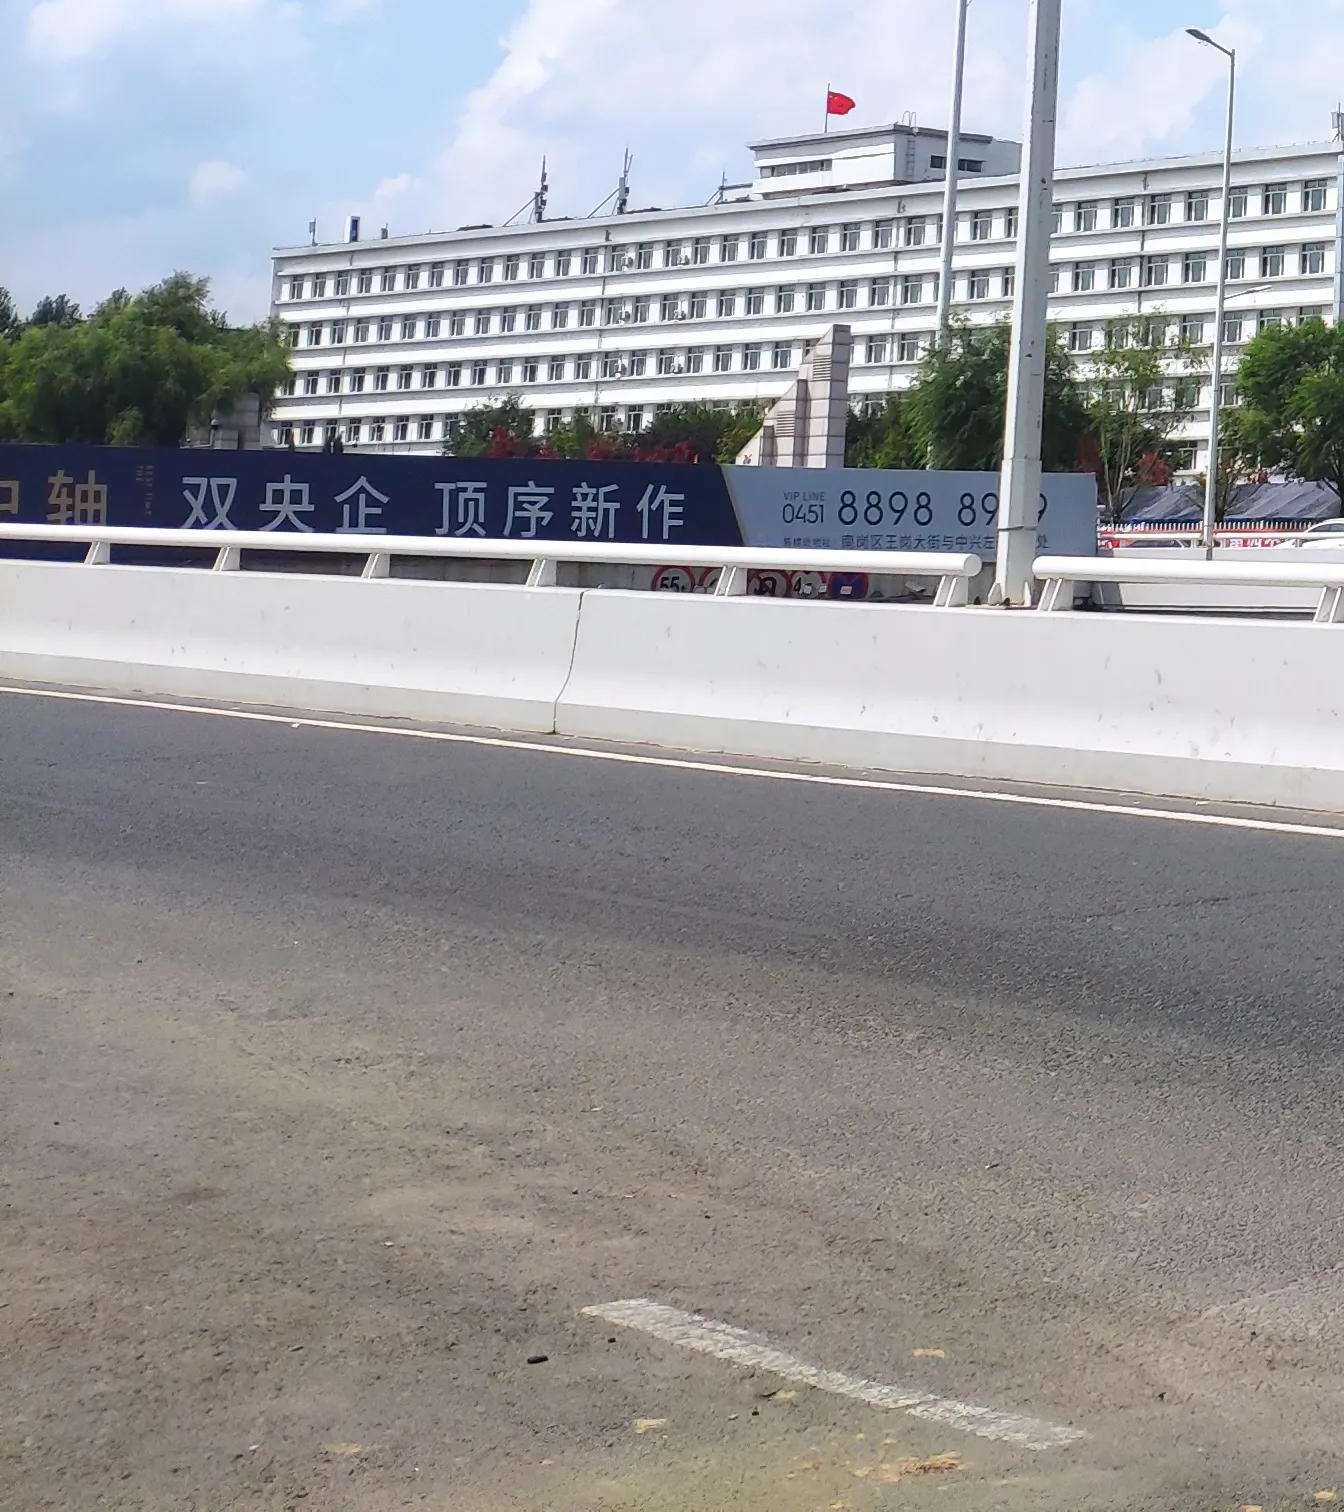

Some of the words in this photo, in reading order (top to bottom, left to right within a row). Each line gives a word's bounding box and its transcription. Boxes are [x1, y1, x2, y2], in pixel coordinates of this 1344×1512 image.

[180, 474, 391, 534] 双央企
[433, 480, 685, 539] 顶序新作
[782, 503, 824, 524] 0451
[838, 490, 933, 525] 8898
